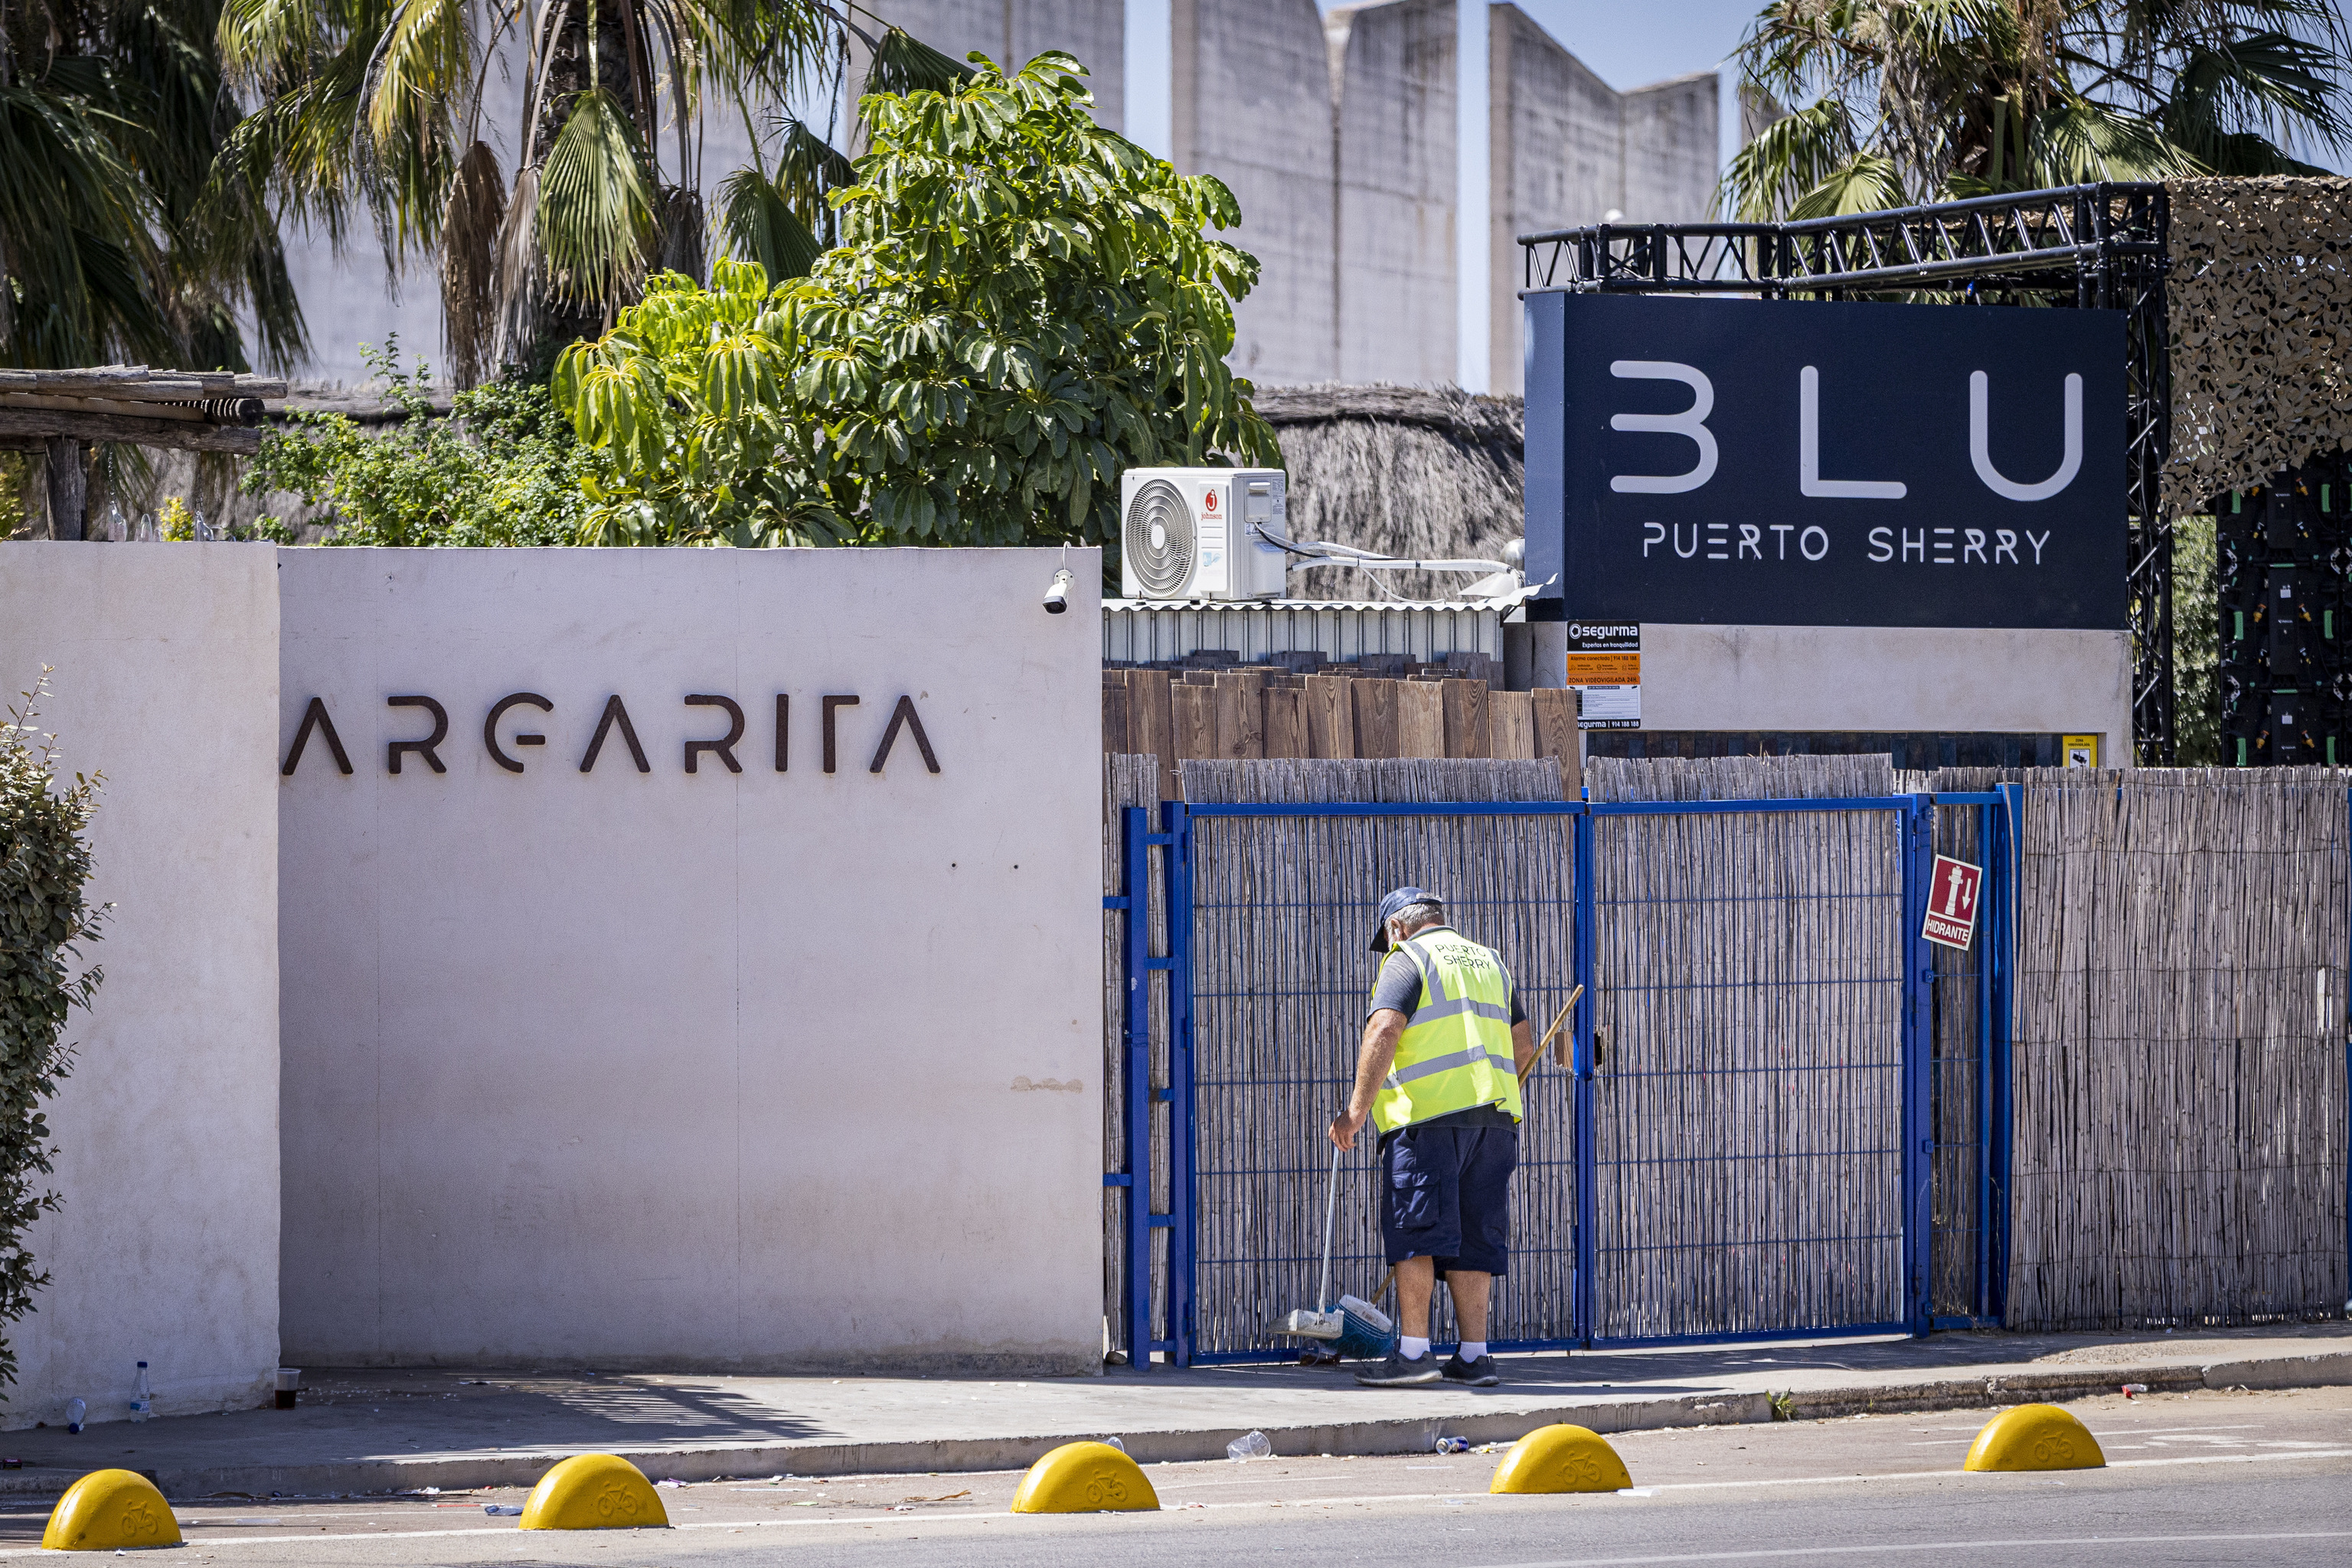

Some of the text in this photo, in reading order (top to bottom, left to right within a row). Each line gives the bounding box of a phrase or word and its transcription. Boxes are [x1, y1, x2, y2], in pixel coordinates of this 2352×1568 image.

[1609, 360, 2082, 501] BLU
[1201, 512, 1223, 521] johnson
[1644, 522, 2050, 564] PUERTO SHERRY
[1583, 626, 1638, 639] segurma
[1926, 919, 1969, 942] HIDRANTE
[1435, 944, 1486, 956] PUERTO
[1443, 955, 1491, 970] SHERRY
